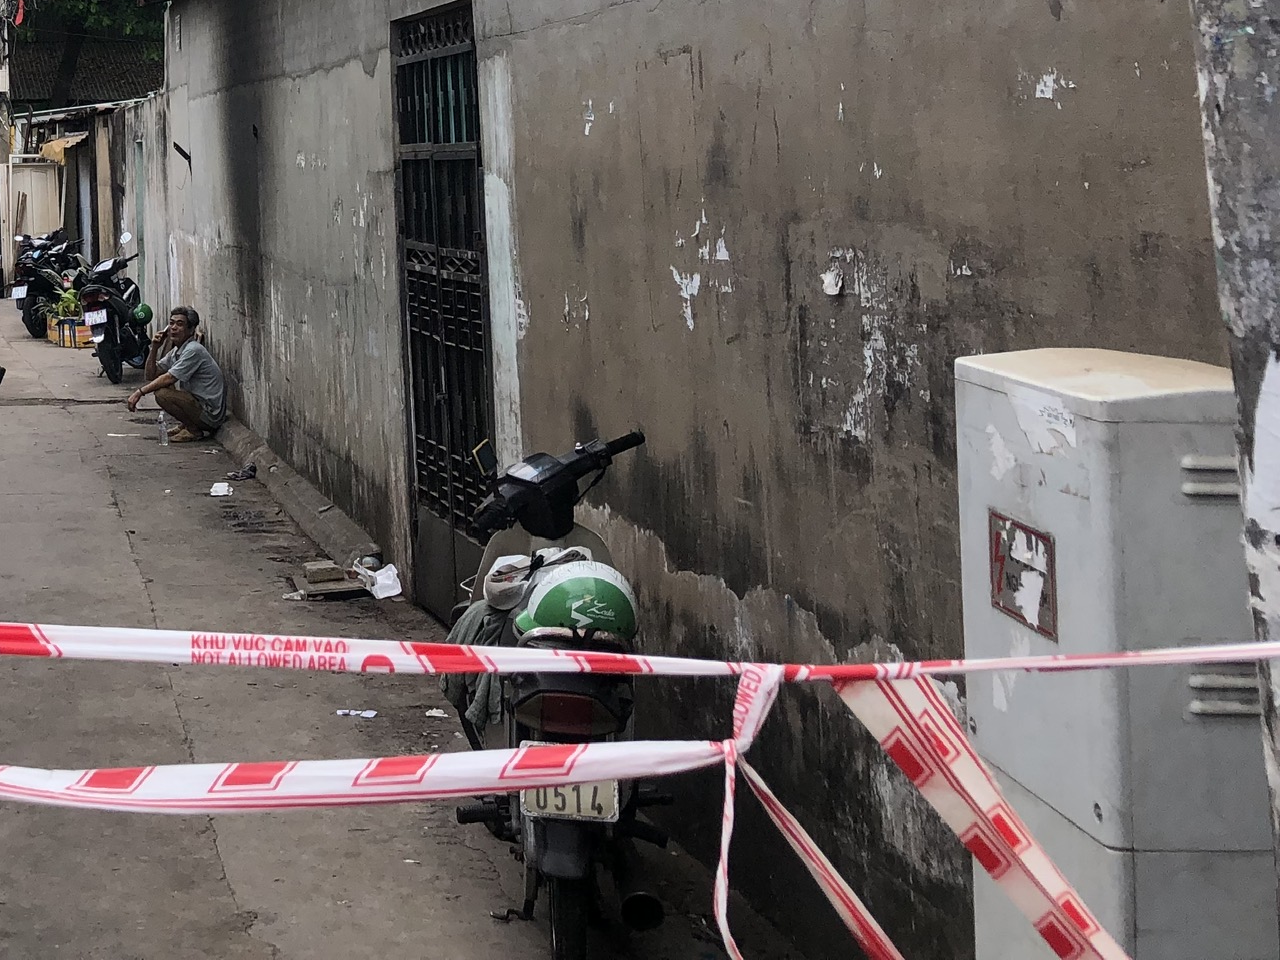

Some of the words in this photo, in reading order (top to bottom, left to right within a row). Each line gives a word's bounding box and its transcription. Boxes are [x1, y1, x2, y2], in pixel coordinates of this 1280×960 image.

[191, 634, 226, 650] KHU
[191, 650, 221, 665] NOT
[308, 654, 347, 671] AREA
